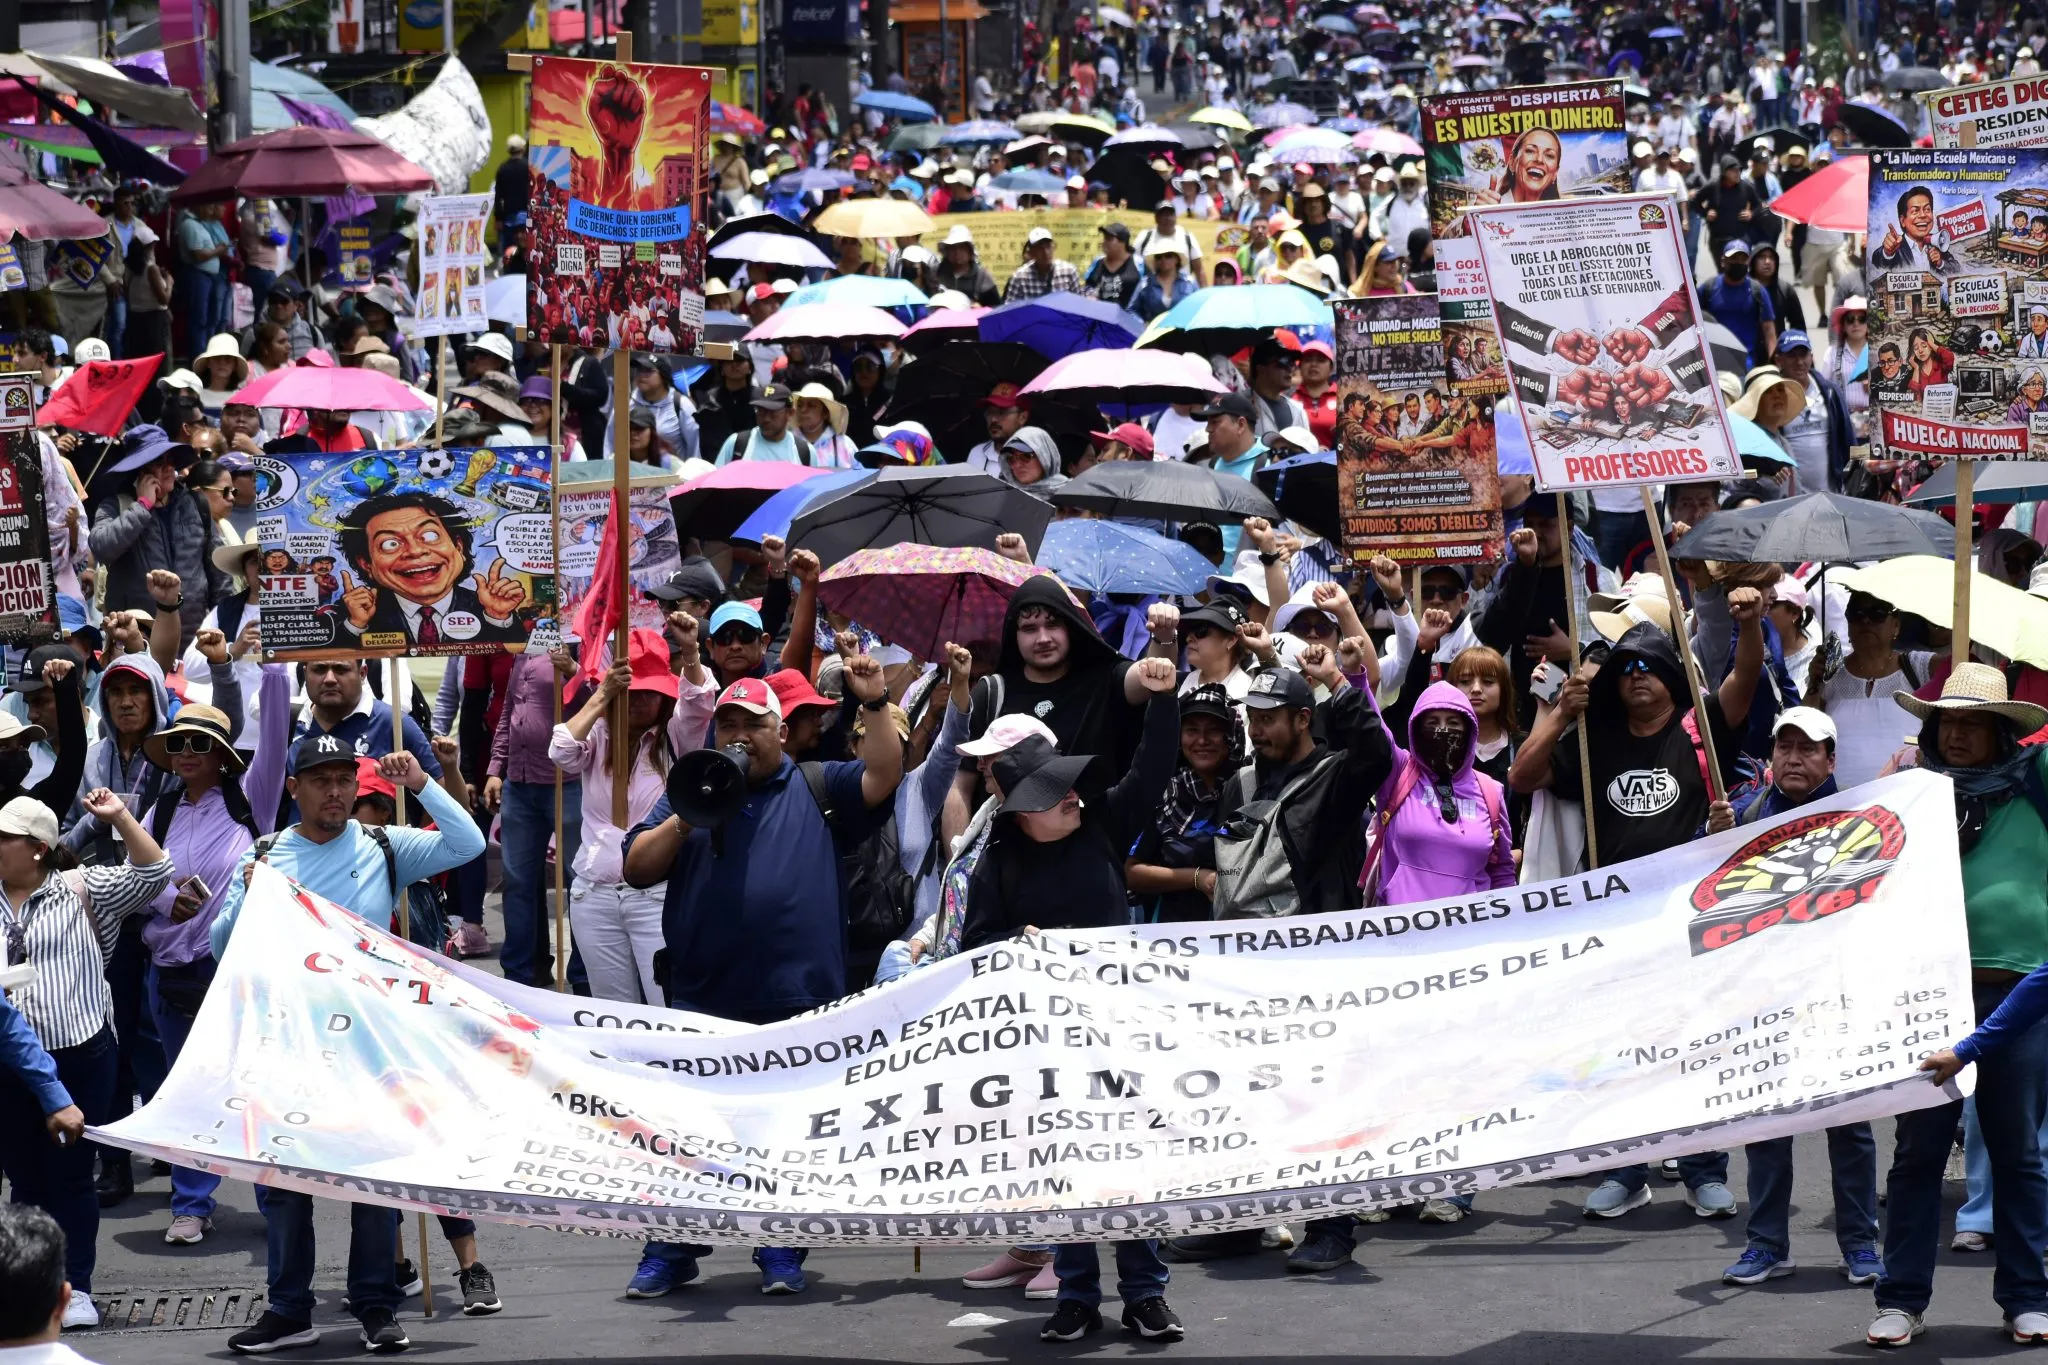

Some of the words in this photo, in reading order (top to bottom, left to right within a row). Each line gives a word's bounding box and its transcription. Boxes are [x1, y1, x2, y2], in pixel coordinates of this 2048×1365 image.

[792, 7, 835, 22] telcel
[1446, 97, 1491, 106] COTIZANTE
[1511, 88, 1600, 107] DESPIERTA
[1938, 86, 2009, 118] CETEG
[2014, 80, 2048, 105] DIG
[1460, 105, 1495, 114] ISSSTE
[1977, 107, 2048, 130] RESIDEN
[1435, 119, 1459, 143] ES
[1463, 110, 1546, 139] NUESTRO
[1551, 106, 1623, 131] DINERO..
[1994, 131, 2015, 141] ESTA
[2017, 127, 2030, 138] EN
[2033, 125, 2045, 134] SU
[1902, 152, 1931, 164] Nueva
[1934, 152, 1967, 164] Escuela
[1969, 152, 2006, 164] Mexicana
[2008, 156, 2016, 164] es
[1882, 169, 1951, 181] Transformadora
[1957, 186, 1977, 196] Delgado
[580, 206, 614, 224] GOBIERNE
[616, 214, 638, 225] QUIEN
[640, 212, 676, 225] GOBIERNE
[1939, 207, 1983, 227] Propaganda
[575, 217, 588, 230] LOS
[590, 221, 627, 237] DERECHOS
[629, 228, 639, 237] SE
[640, 223, 682, 237] DEFIENDEN
[559, 247, 583, 259] CETEG
[1511, 252, 1539, 266] URGE
[1544, 250, 1557, 262] LA
[1561, 242, 1633, 261] ABROGACIÓN
[1638, 242, 1652, 254] DE
[560, 260, 583, 272] DIGNA
[660, 260, 681, 269] CNTE
[1436, 262, 1451, 271] EL
[1522, 266, 1535, 278] LA
[1537, 264, 1555, 276] LEY
[1559, 262, 1578, 274] DEL
[1581, 259, 1614, 272] ISSSTE
[1616, 257, 1642, 269] 2007
[1644, 256, 1651, 267] Y
[1522, 278, 1555, 290] TODAS
[1559, 274, 1577, 286] LAS
[1579, 269, 1654, 285] AFECTACIONES
[1889, 275, 1919, 283] ESCUELA
[1955, 279, 1998, 293] ESCUELAS
[1440, 287, 1468, 296] PARA
[1519, 291, 1538, 304] QUE
[1542, 288, 1562, 301] CON
[1564, 286, 1589, 299] ELLA
[1591, 284, 1604, 295] SE
[1605, 280, 1665, 295] DERIVARON.
[1955, 296, 1964, 304] EN
[1966, 291, 2000, 303] RUINAS
[1956, 306, 1967, 315] SIN
[1969, 304, 2000, 314] RECURSOS
[1358, 322, 1368, 334] LA
[1370, 320, 1401, 333] UNIDAD
[1510, 320, 1544, 341] Calderón
[1654, 311, 1676, 332] AMLO
[1372, 333, 1386, 345] NO
[1388, 332, 1410, 344] TIENE
[1412, 330, 1441, 342] SIGLAS
[1521, 375, 1545, 393] Nieto
[1892, 418, 1960, 448] HUELGA
[1962, 432, 2021, 449] NACIONAL
[1564, 448, 1709, 483] PROFESORES
[509, 489, 536, 500] MUNDIAL
[1366, 486, 1388, 494] Entender
[1408, 483, 1429, 491] derechos
[511, 496, 530, 505] 2026
[1444, 494, 1471, 504] magisterio
[1349, 518, 1397, 533] DIVIDIDOS
[1400, 516, 1437, 532] SOMOS
[506, 540, 544, 548] ESCOLAR
[1353, 549, 1380, 560] UNIDOS
[1386, 548, 1435, 559] ORGANIZADOS
[1436, 545, 1483, 558] VENCEREMOS
[273, 597, 316, 605] DERECHOS
[448, 617, 475, 626] SEP
[365, 638, 404, 646] DELGADO
[1617, 770, 1667, 797] VANS
[1209, 897, 1511, 956] TRABAJADORES
[1521, 884, 1573, 914] DE
[1582, 873, 1631, 902] LA
[970, 949, 1191, 986] EDUCACIÓN
[900, 992, 1037, 1041] ESTATAL
[1048, 994, 1094, 1020] DE
[1187, 964, 1490, 1021] TRABAJADORES
[1501, 948, 1548, 976] DE
[1561, 935, 1605, 961] LA
[1689, 1027, 1741, 1051] son
[1752, 1004, 1796, 1029] los
[1901, 1025, 1951, 1048] del
[1679, 1053, 1721, 1075] los
[1732, 1030, 1791, 1058] que
[1904, 1005, 1949, 1027] los
[844, 1020, 1050, 1087] EDUCACIÓN
[1063, 1023, 1112, 1048] EN
[1839, 1058, 1895, 1082] son
[781, 1149, 827, 1166] DE
[838, 1142, 876, 1164] LA
[887, 1126, 942, 1155] LEY
[954, 1118, 1017, 1146] DEL
[1028, 1108, 1136, 1137] ISSSTE
[880, 1158, 969, 1187] PARA
[980, 1151, 1017, 1174] EL
[1027, 1131, 1257, 1169] MAGISTERIO.
[1154, 1171, 1264, 1201] ISSSTE
[1276, 1159, 1322, 1180] EN
[1333, 1148, 1376, 1167] LA
[1386, 1107, 1536, 1157] CAPITAL.
[1414, 1145, 1460, 1169] EN
[847, 1193, 889, 1207] LA
[900, 1176, 1073, 1206] USICAMM
